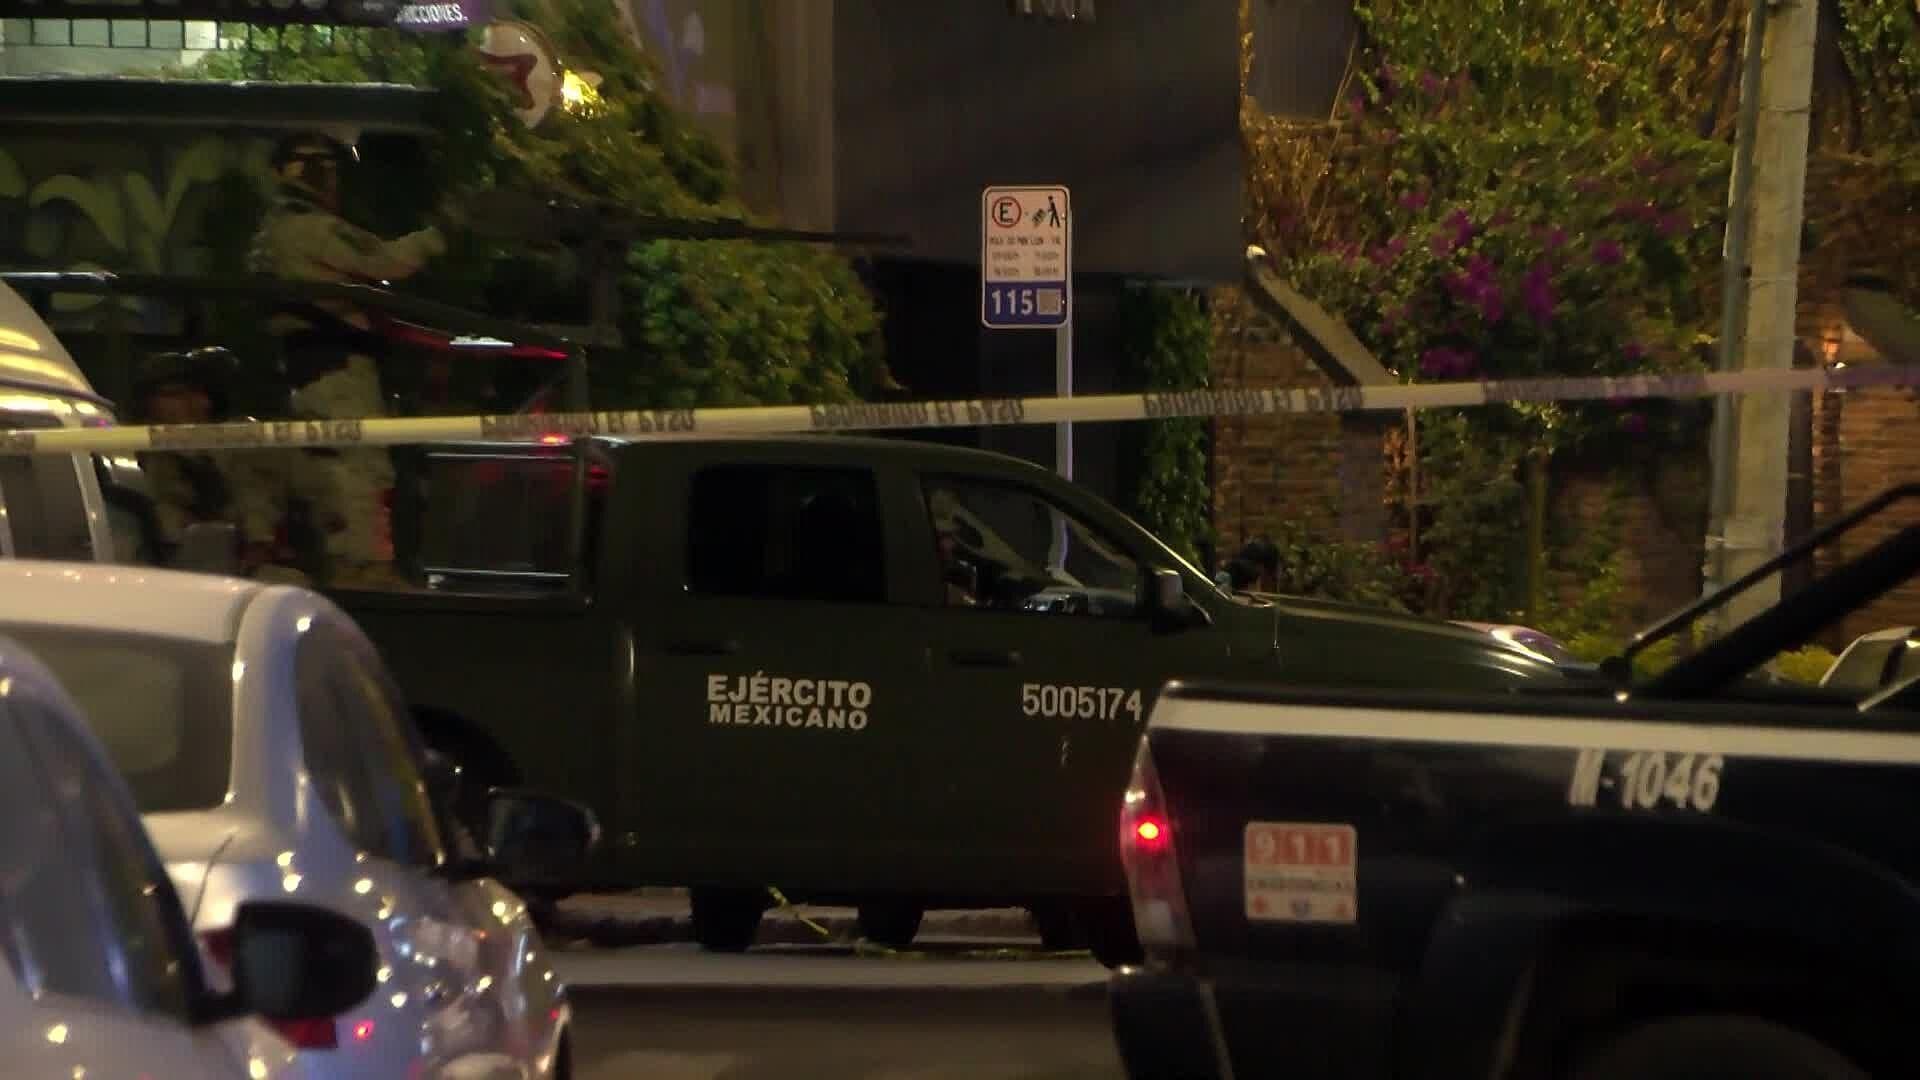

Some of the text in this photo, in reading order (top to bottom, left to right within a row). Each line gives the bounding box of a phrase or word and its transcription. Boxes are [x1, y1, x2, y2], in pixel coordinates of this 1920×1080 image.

[999, 202, 1014, 223] E
[991, 289, 1033, 315] 115
[707, 670, 872, 708] EJÉRCITO
[1023, 683, 1142, 721] 5005174
[709, 703, 868, 730] MEXICANO
